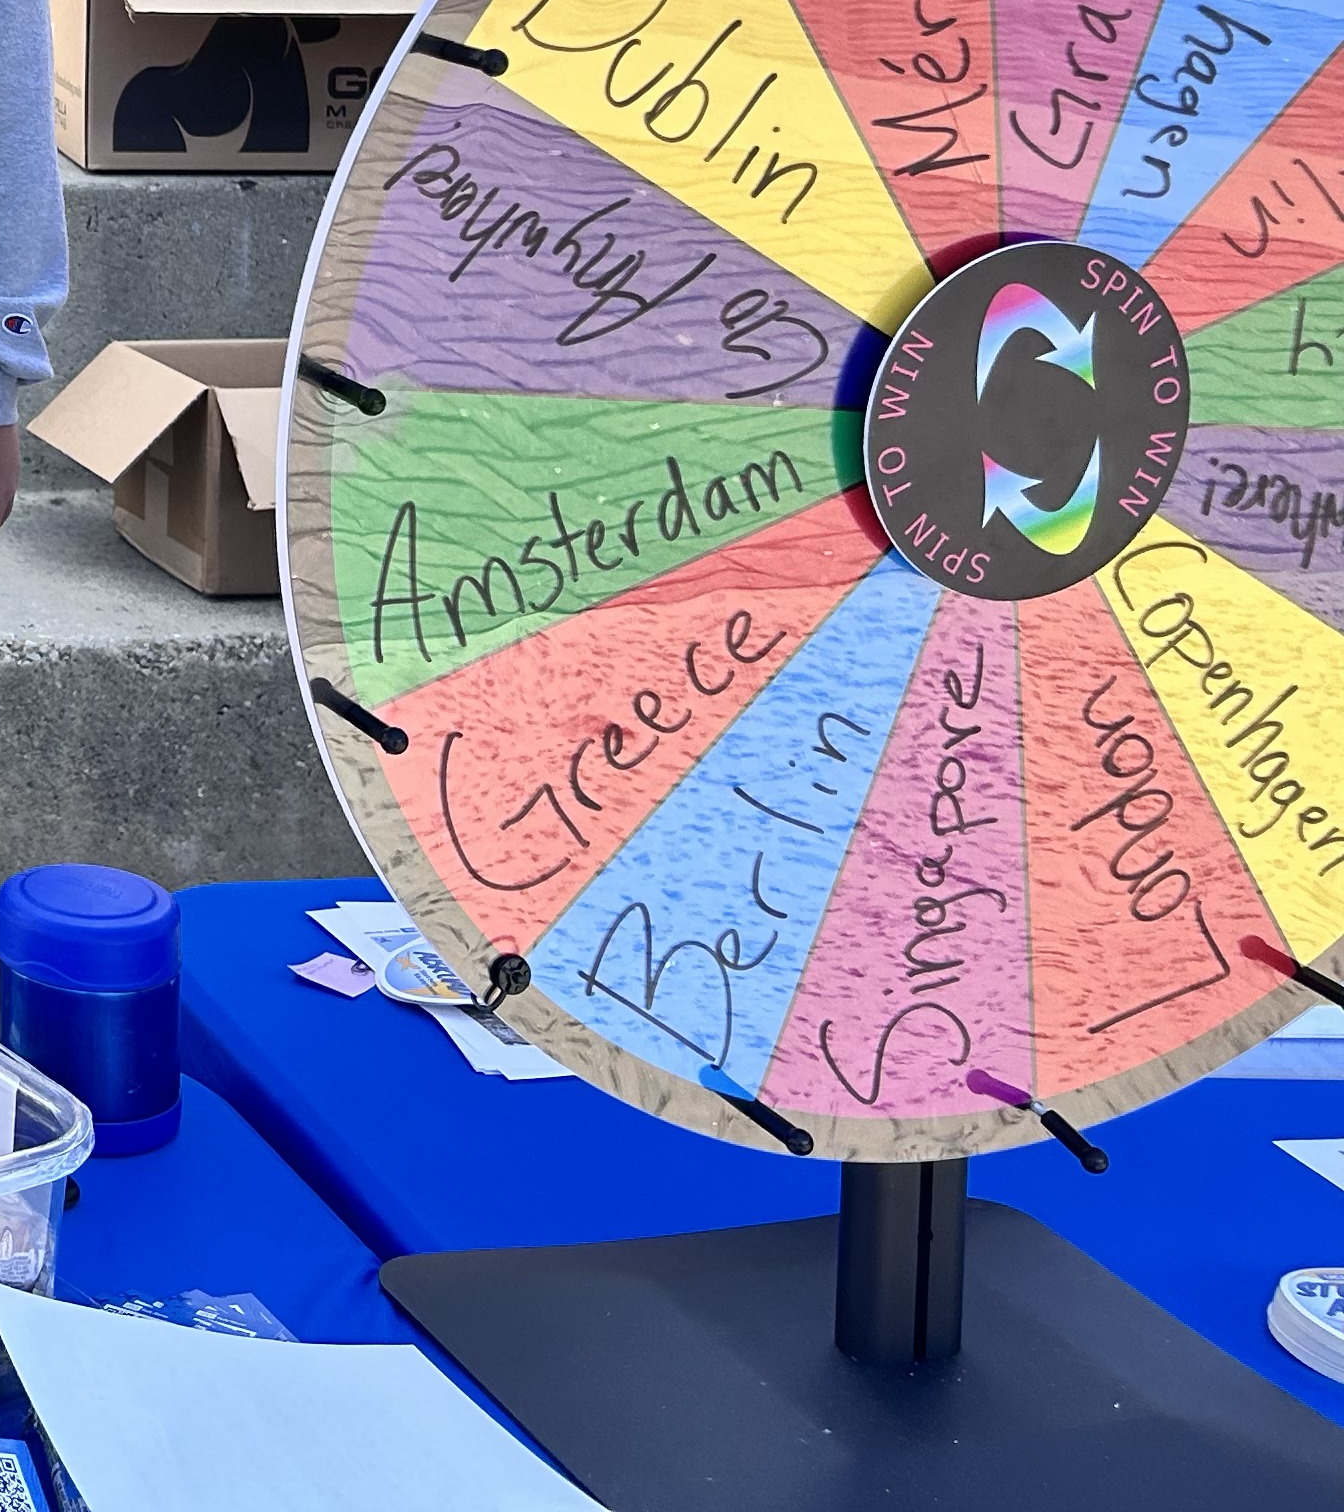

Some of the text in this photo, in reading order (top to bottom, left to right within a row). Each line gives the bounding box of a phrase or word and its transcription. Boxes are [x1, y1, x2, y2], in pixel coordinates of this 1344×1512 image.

[719, 288, 830, 400] Go
[877, 330, 992, 583] SPIN TO WIN
[1080, 258, 1181, 518] SPIN TO WIN
[371, 450, 804, 665] Amsterdam
[438, 609, 789, 892] Greece
[1112, 540, 1344, 879] Copenhagen
[577, 711, 872, 1070] Berlin
[819, 641, 1009, 1108] Singapore
[1070, 674, 1232, 1035] London
